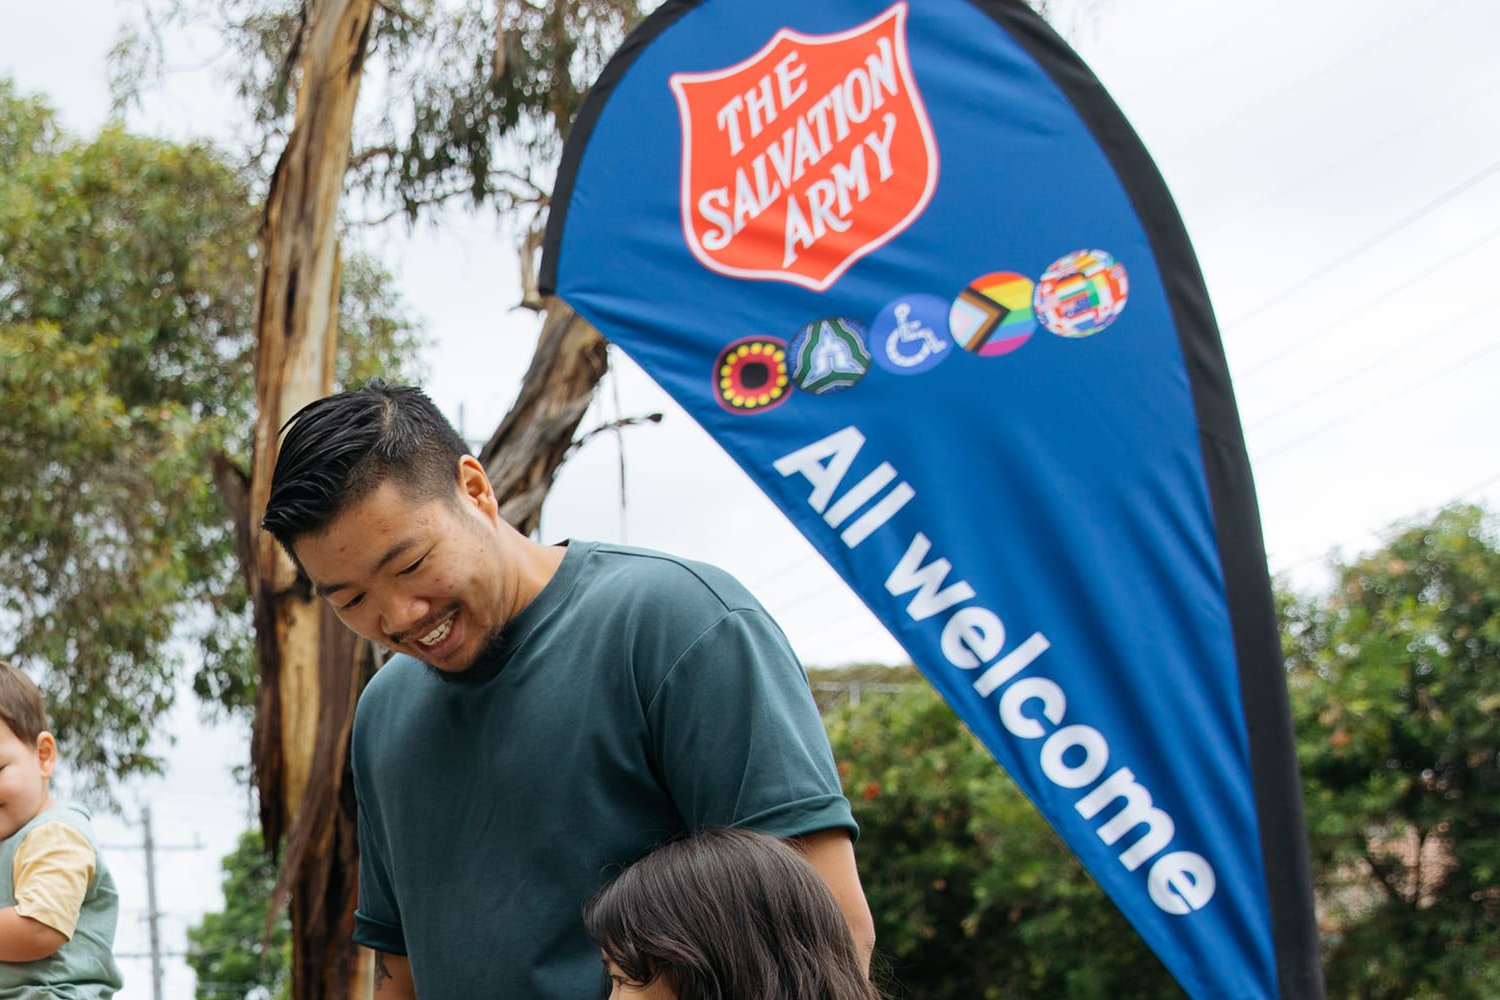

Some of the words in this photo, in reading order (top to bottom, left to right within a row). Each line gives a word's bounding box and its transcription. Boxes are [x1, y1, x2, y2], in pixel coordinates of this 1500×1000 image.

[698, 36, 898, 250] SALVATION
[716, 50, 807, 157] THE
[782, 112, 896, 269] ARMY
[773, 425, 916, 549] All
[884, 531, 1216, 915] welcome
